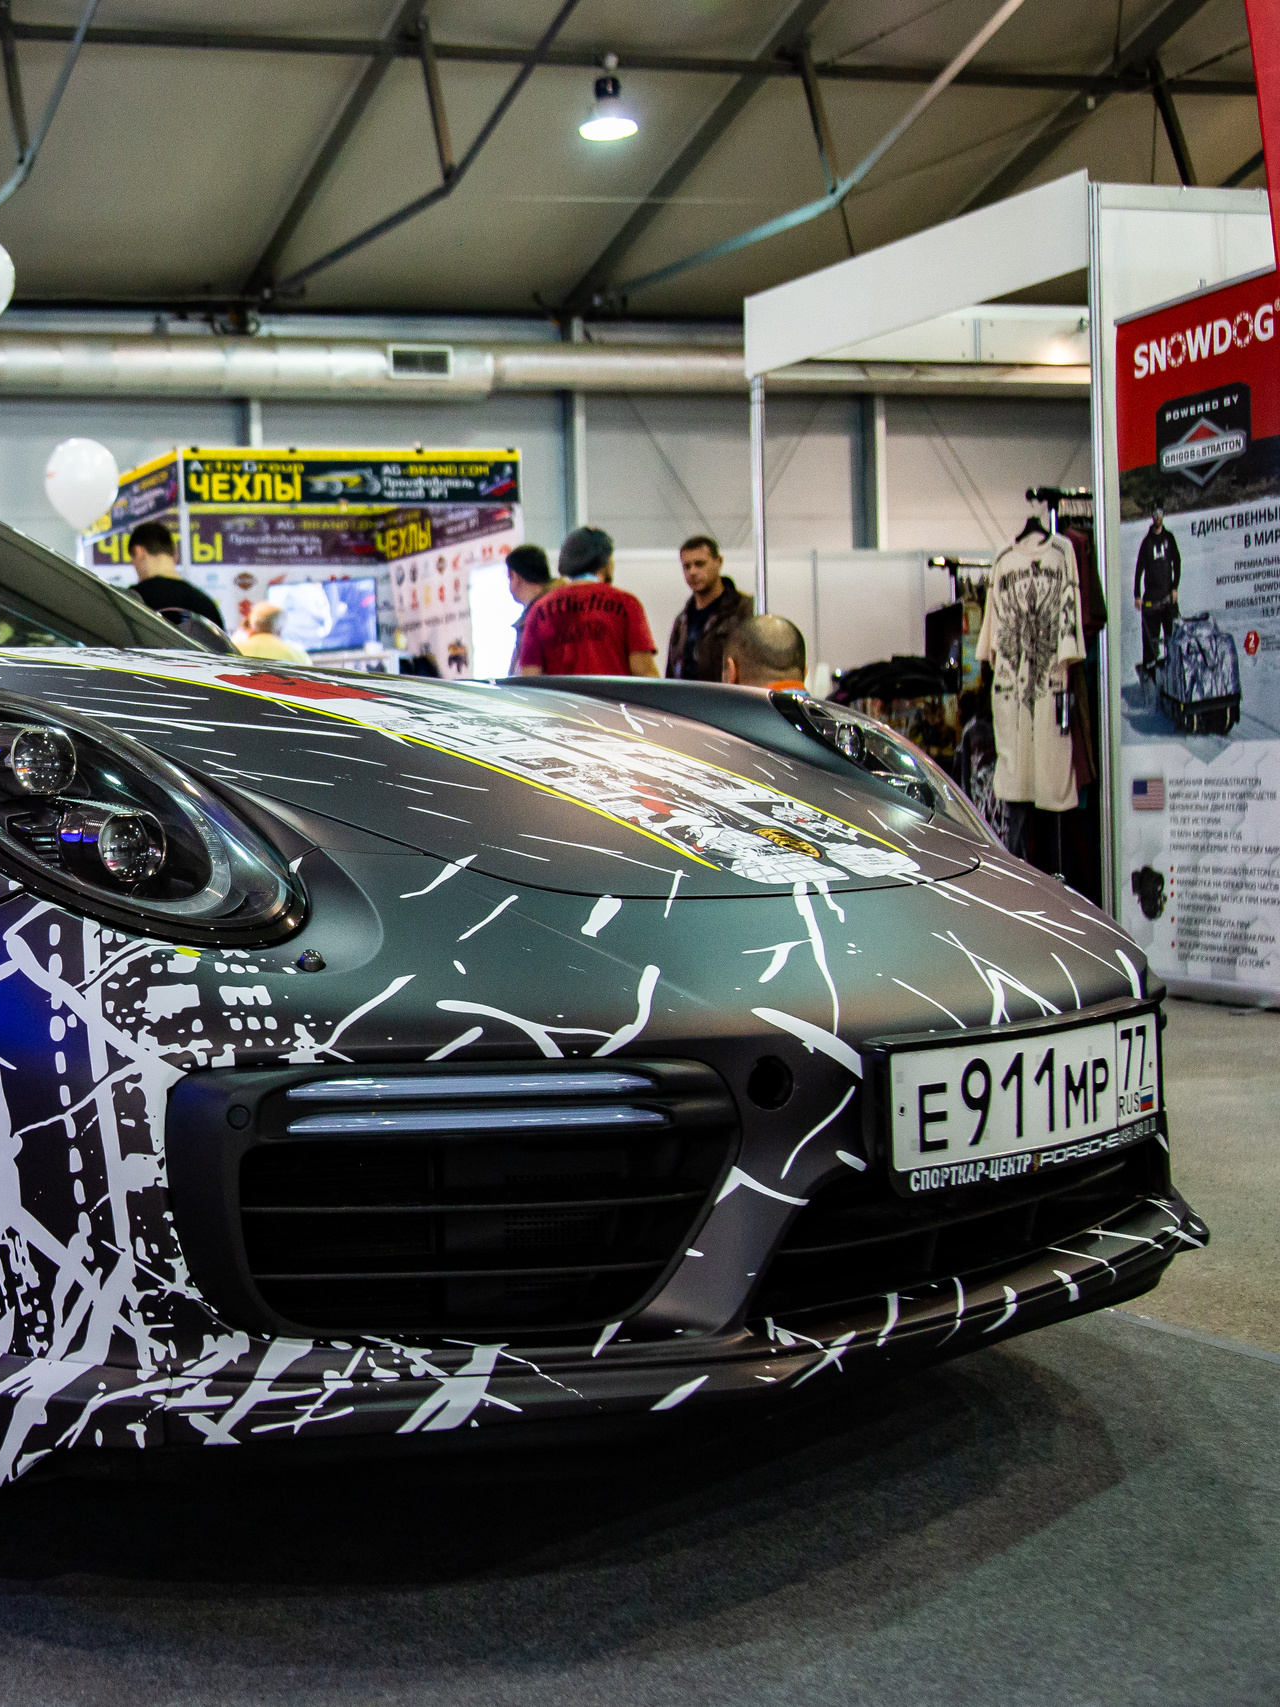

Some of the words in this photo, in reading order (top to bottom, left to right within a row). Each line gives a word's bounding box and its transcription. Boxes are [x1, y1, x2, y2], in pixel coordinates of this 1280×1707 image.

[1133, 303, 1275, 380] SNOWDOG
[1165, 399, 1220, 422] POWERED
[1223, 393, 1239, 408] BY
[188, 472, 303, 502] ЧЕХЛЫ
[1190, 507, 1280, 539] ЕДИНСТВЕННЫ
[1244, 532, 1252, 549] В
[1120, 1024, 1147, 1091] 77
[1118, 1092, 1140, 1118] RUS
[910, 1152, 1032, 1192] СПОРТКАР-ЦЕНТР
[1039, 1132, 1120, 1167] PORSCHE
